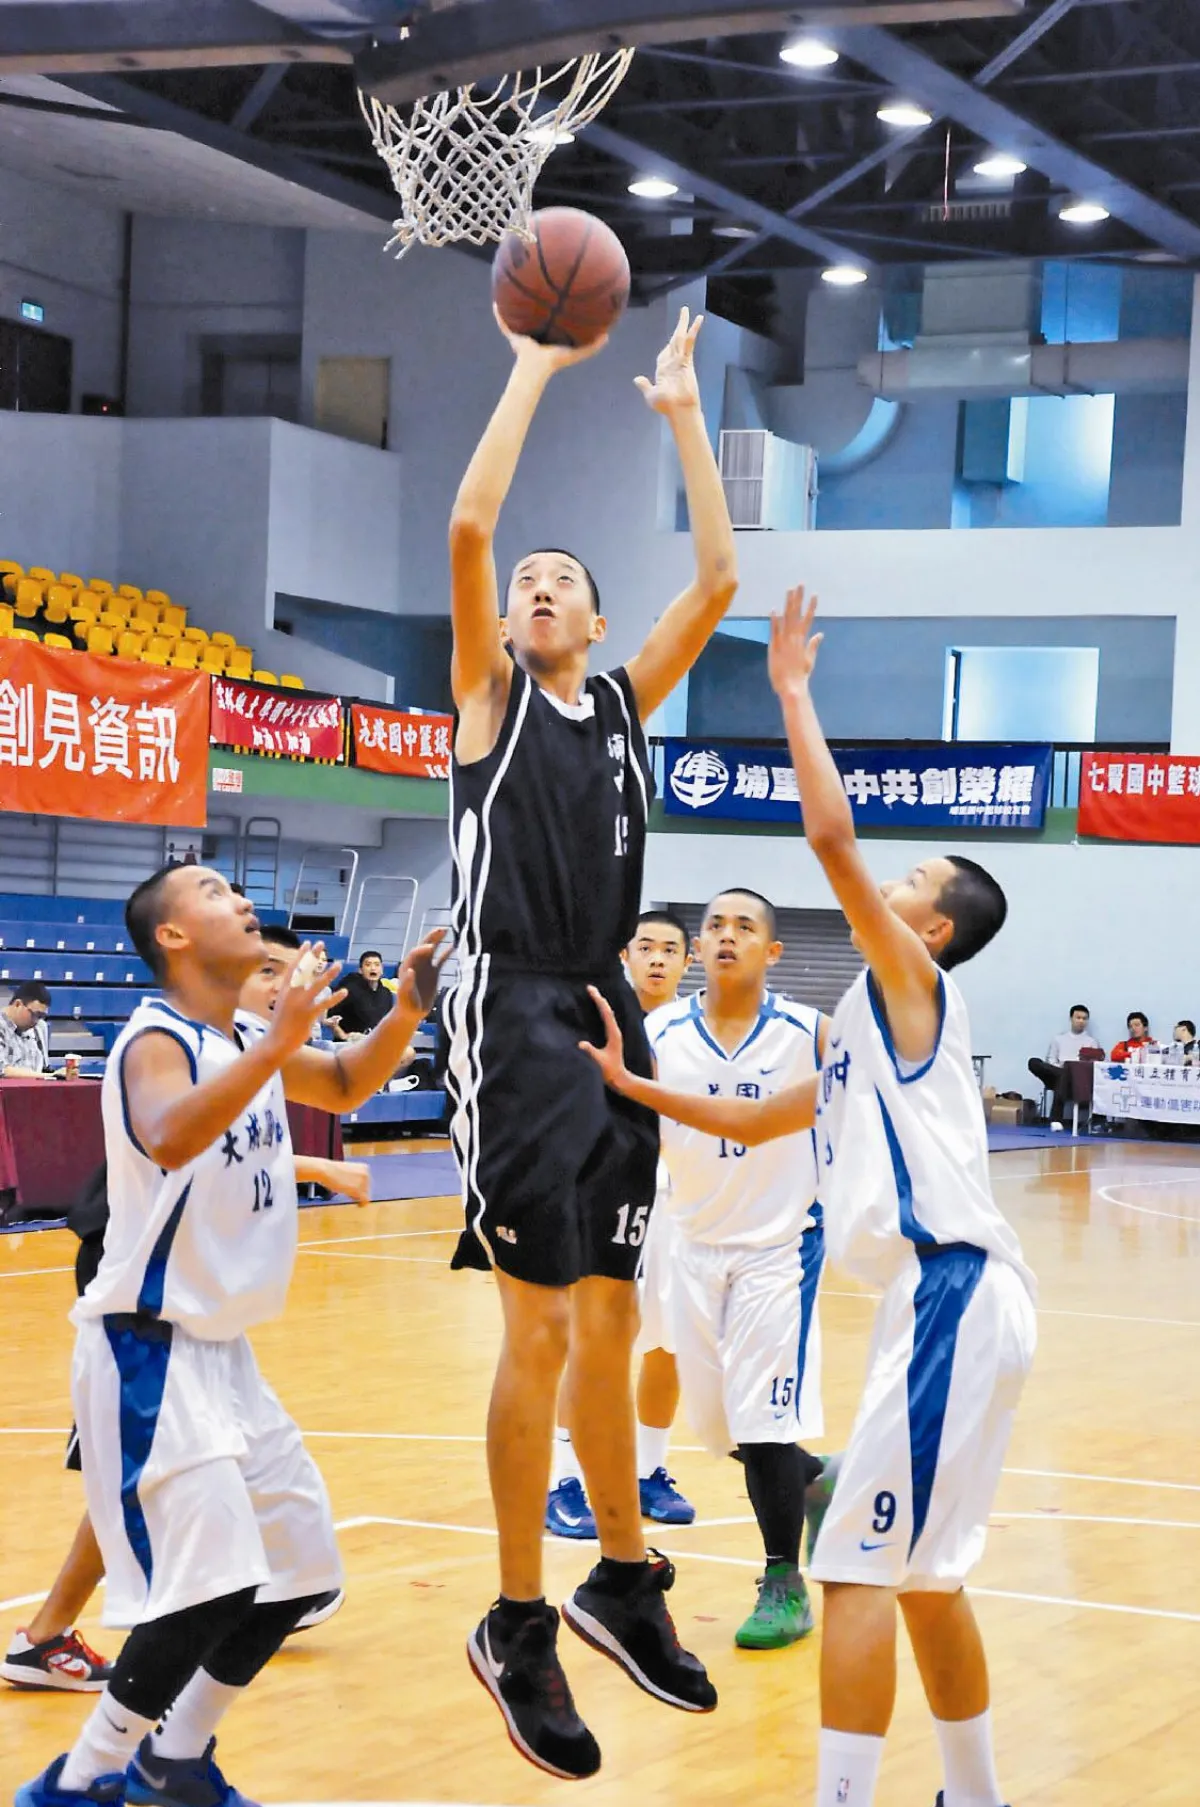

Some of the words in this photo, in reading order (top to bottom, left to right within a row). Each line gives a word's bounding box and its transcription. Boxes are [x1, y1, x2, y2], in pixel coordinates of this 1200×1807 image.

[0, 679, 180, 784] 創見資訊
[733, 764, 1036, 805] 埔里中共創榮耀
[252, 1168, 274, 1212] 12
[611, 1203, 649, 1247] 15
[770, 1376, 794, 1406] 15
[872, 1490, 897, 1534] 9
